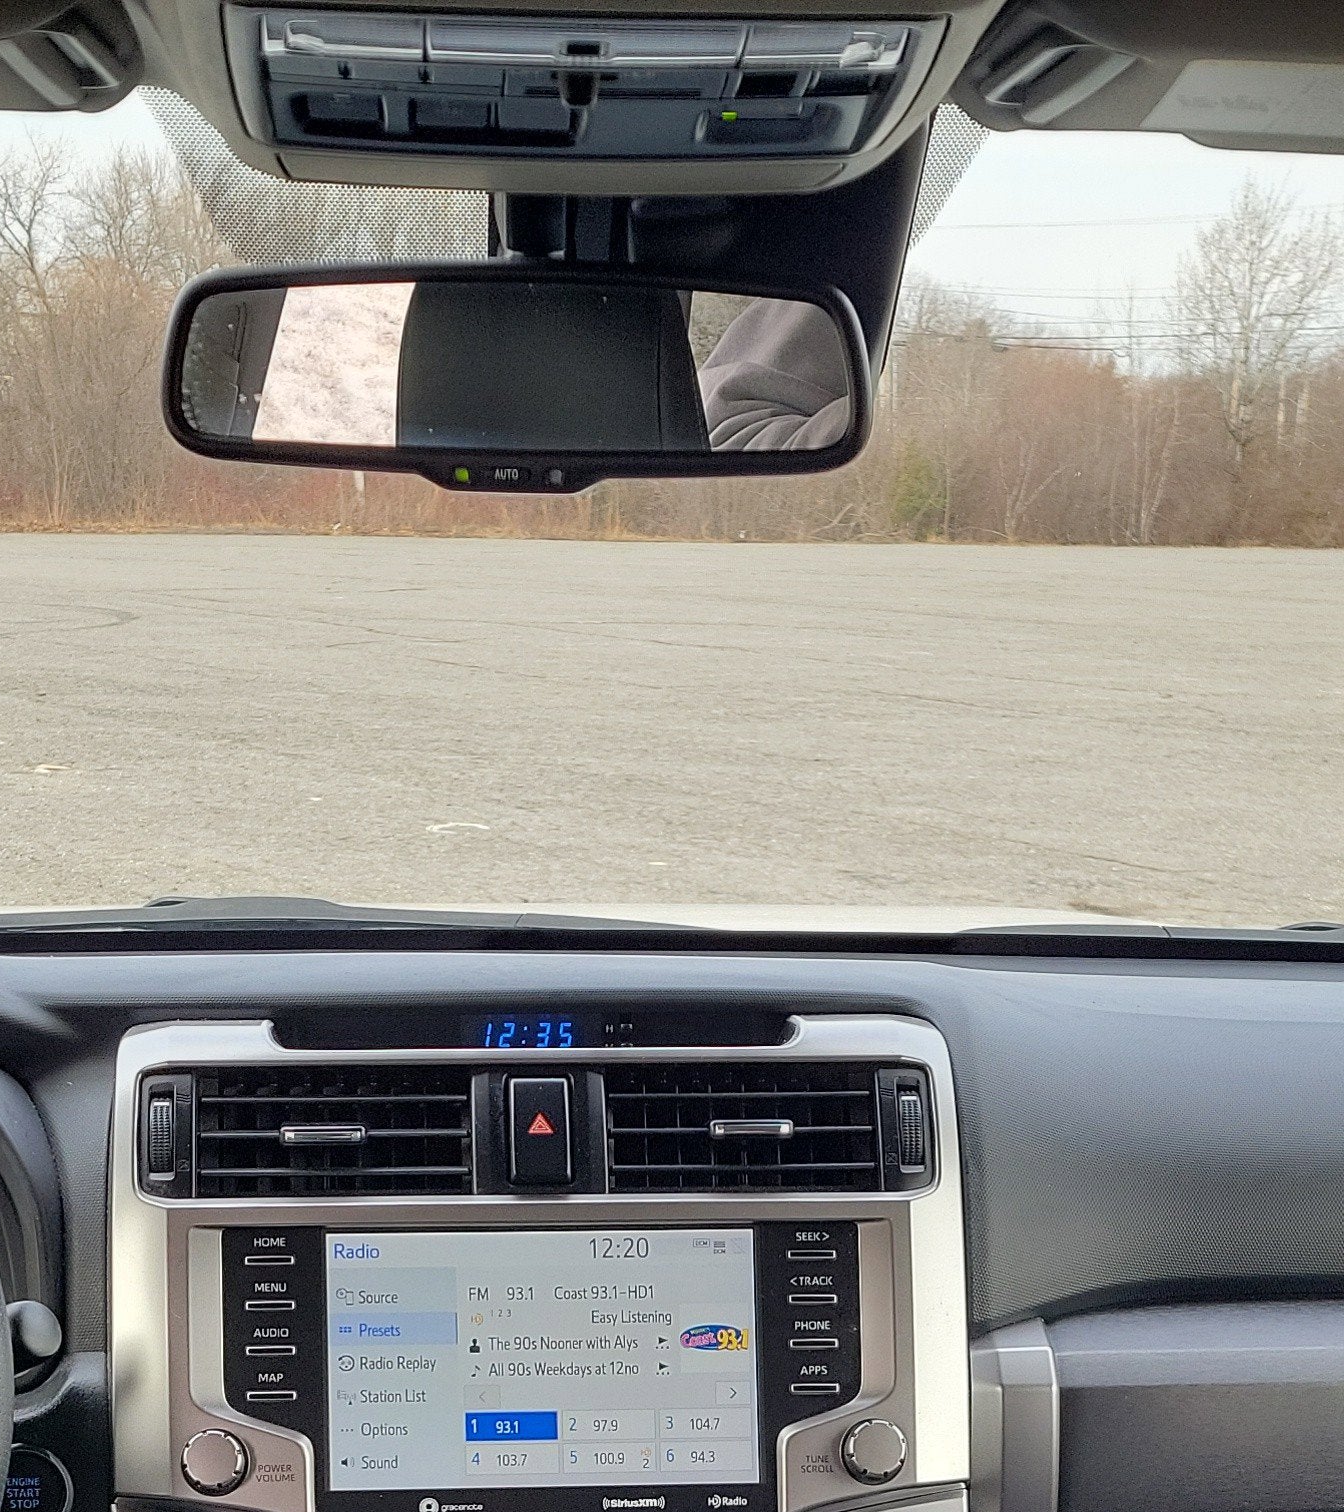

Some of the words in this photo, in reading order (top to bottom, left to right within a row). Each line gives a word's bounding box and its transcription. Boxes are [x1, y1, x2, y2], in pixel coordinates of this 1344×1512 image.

[494, 468, 519, 480] AUTO
[484, 1022, 573, 1048] 12:35
[253, 1237, 287, 1247] HOME
[589, 1237, 649, 1259] 12:20
[334, 1243, 380, 1259] Radio
[254, 1283, 287, 1292] MENU
[468, 1287, 489, 1301] FM
[507, 1286, 534, 1300] 93.1
[554, 1286, 588, 1300] Coast
[358, 1290, 398, 1304] Source
[591, 1310, 618, 1326] Easy
[621, 1309, 672, 1326] Listening
[253, 1328, 289, 1338] AUDIO
[359, 1322, 401, 1337] Presets
[794, 1321, 831, 1331] PHONE
[488, 1337, 511, 1350] The
[514, 1336, 537, 1350] 90s
[540, 1336, 583, 1350] Nooner
[586, 1335, 611, 1349] with
[614, 1336, 638, 1352] Alys
[717, 1328, 749, 1350] 93.1
[360, 1355, 394, 1370] Radio
[396, 1355, 437, 1372] Replay
[488, 1362, 504, 1377] All
[508, 1362, 532, 1376] 90s
[535, 1361, 592, 1378] Weekdays
[595, 1364, 607, 1375] at
[610, 1361, 639, 1375] 12no
[800, 1365, 828, 1376] APPS
[258, 1373, 284, 1383] MAP
[360, 1389, 402, 1403] Station
[405, 1389, 426, 1403] List
[361, 1422, 408, 1438] Options
[471, 1418, 477, 1434] 1
[496, 1420, 519, 1433] 93.1
[569, 1418, 577, 1431] 2
[593, 1420, 618, 1431] 97.9
[666, 1416, 674, 1429] 3
[690, 1418, 720, 1430] 104.7
[361, 1455, 398, 1469] Sound
[471, 1452, 480, 1466] 4
[497, 1454, 527, 1466] 103.7
[570, 1450, 578, 1464] 5
[594, 1452, 625, 1464] 100.9
[666, 1449, 675, 1462] 6
[690, 1450, 716, 1463] 94.3
[805, 1454, 829, 1463] TUNE
[257, 1464, 292, 1473] POWER
[642, 1458, 649, 1469] 2
[800, 1464, 833, 1473] SCROLL
[6, 1477, 40, 1487] ENGINE
[256, 1474, 296, 1482] VOLUME
[6, 1488, 41, 1498] START
[9, 1500, 40, 1509] STOP
[722, 1496, 748, 1506] Radio
